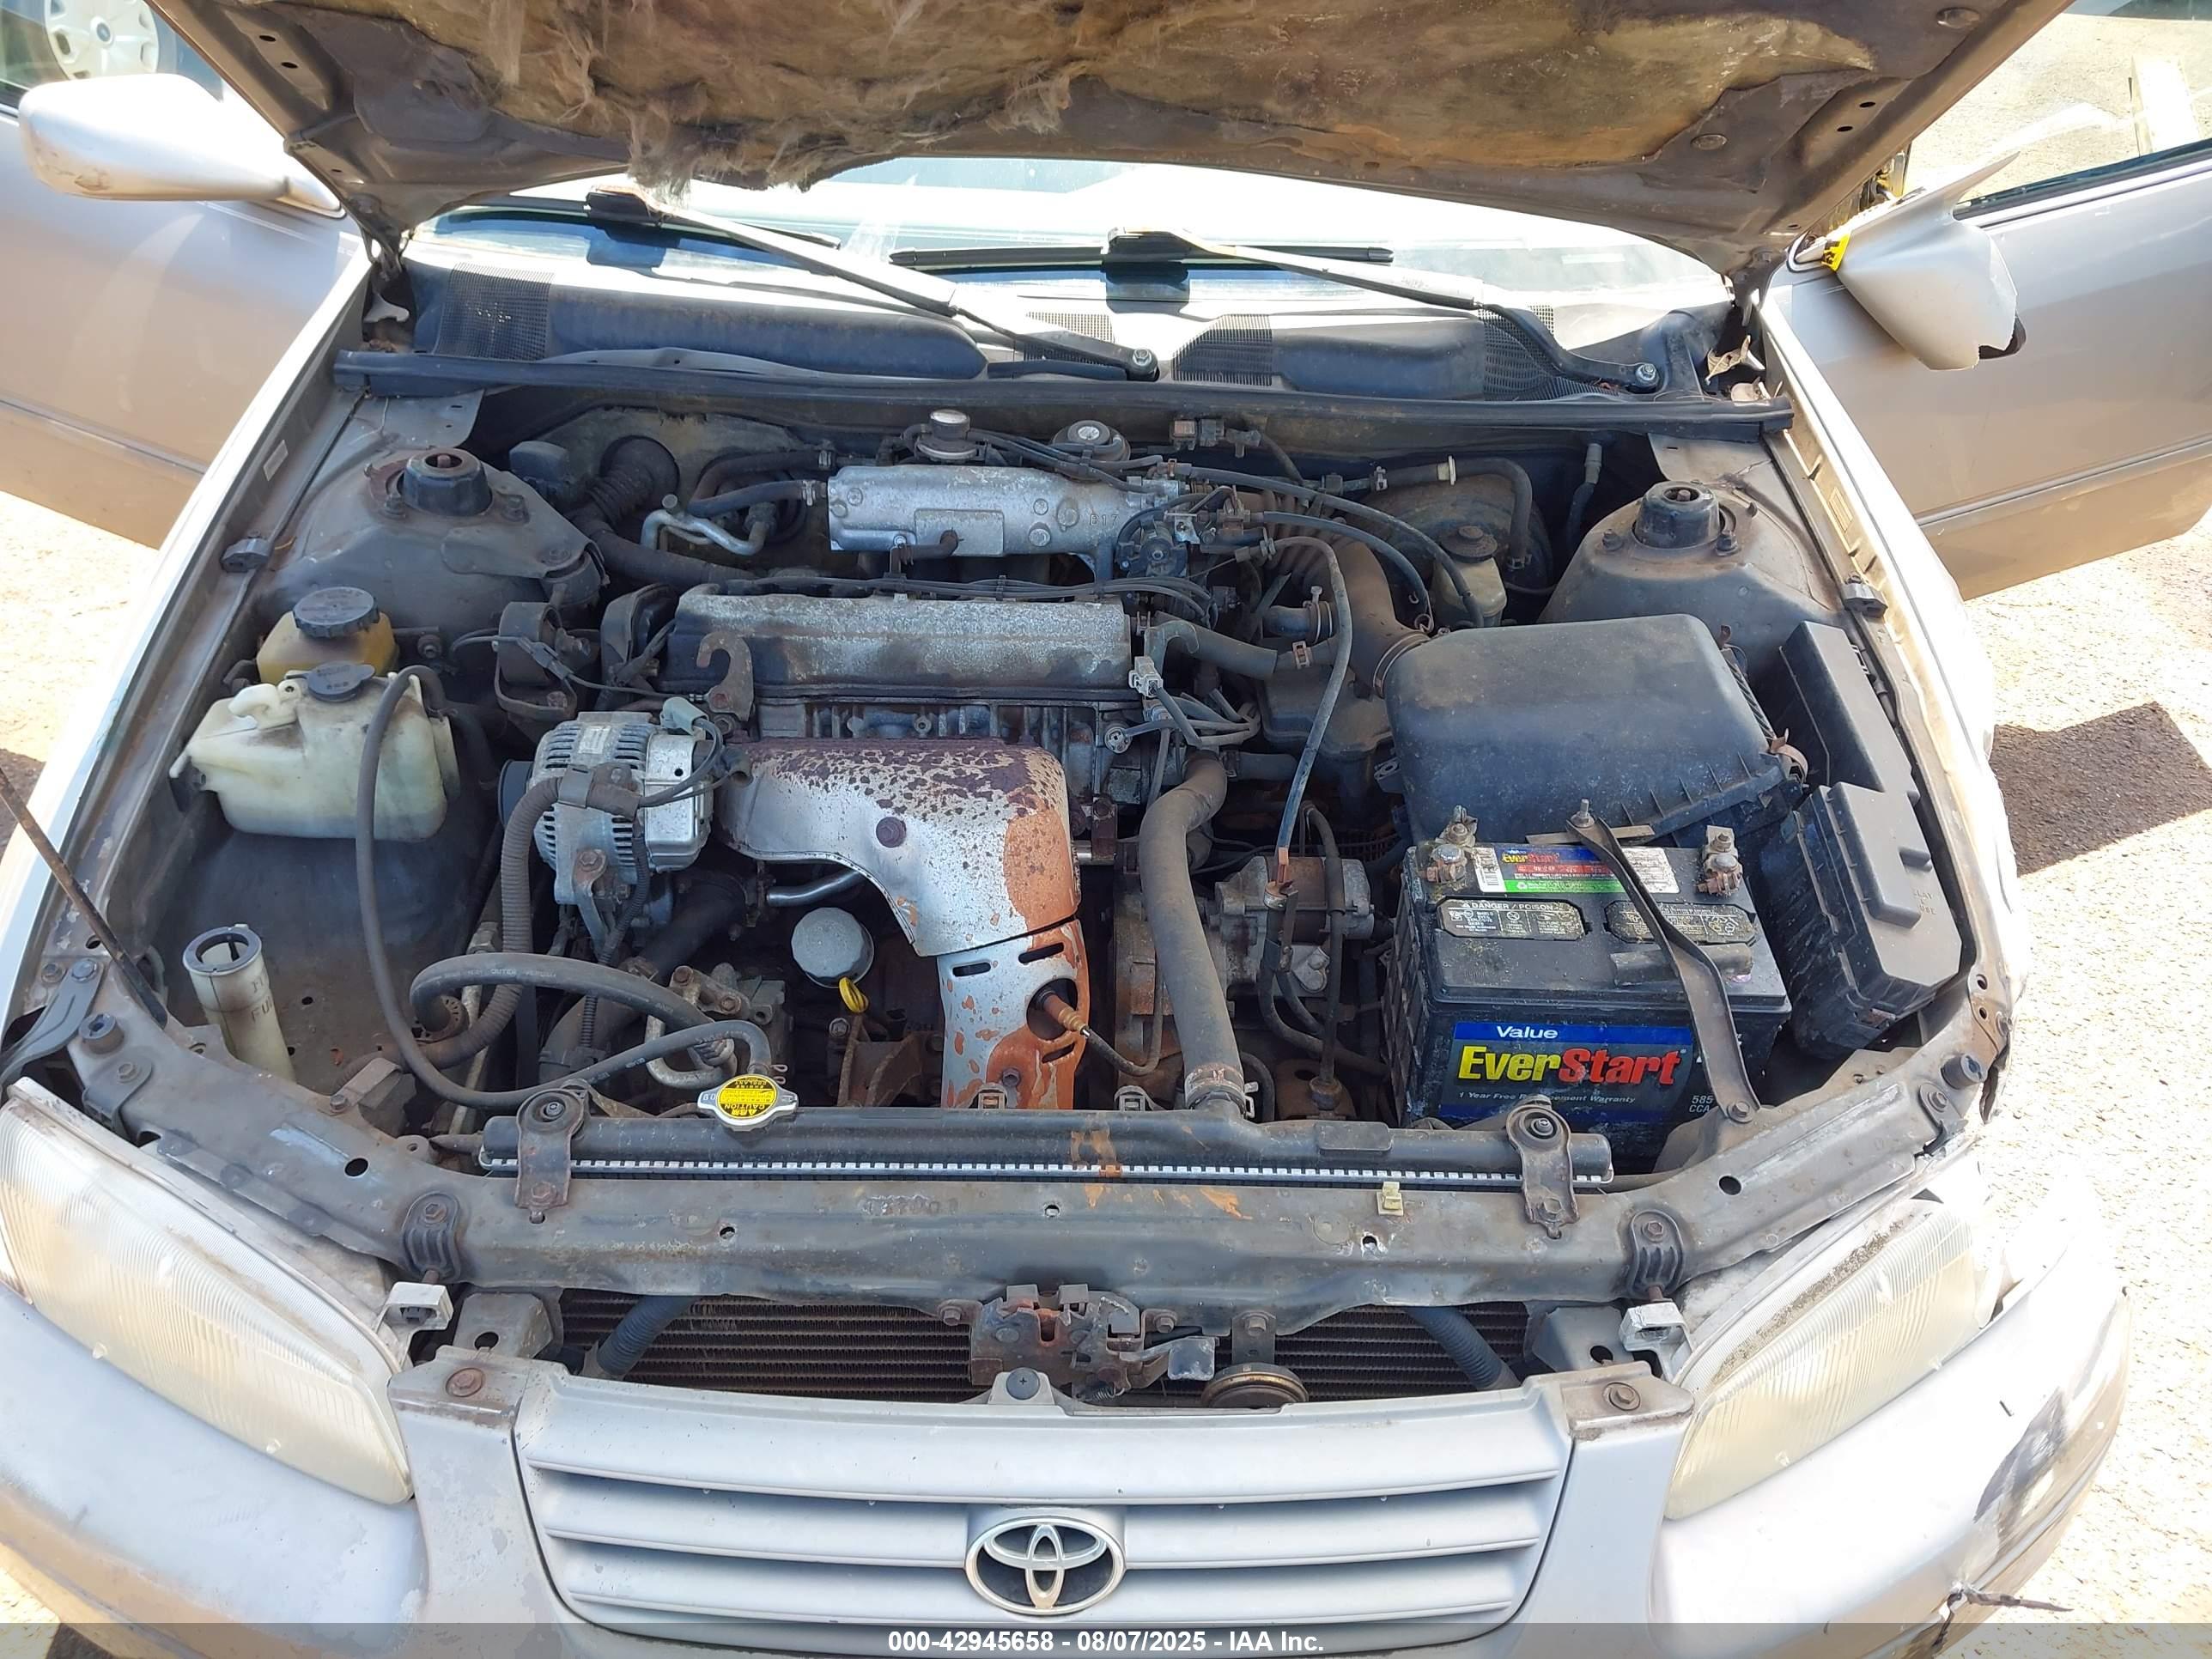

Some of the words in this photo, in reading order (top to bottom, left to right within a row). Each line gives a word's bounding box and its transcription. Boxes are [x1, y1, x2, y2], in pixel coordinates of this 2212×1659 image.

[1090, 514, 1119, 526] B17
[1497, 1025, 1559, 1040] Value
[1457, 1044, 1682, 1085] EverStart
[1589, 1094, 1636, 1103] Warranty
[1692, 1095, 1714, 1104] 585
[1689, 1104, 1711, 1113] CCA
